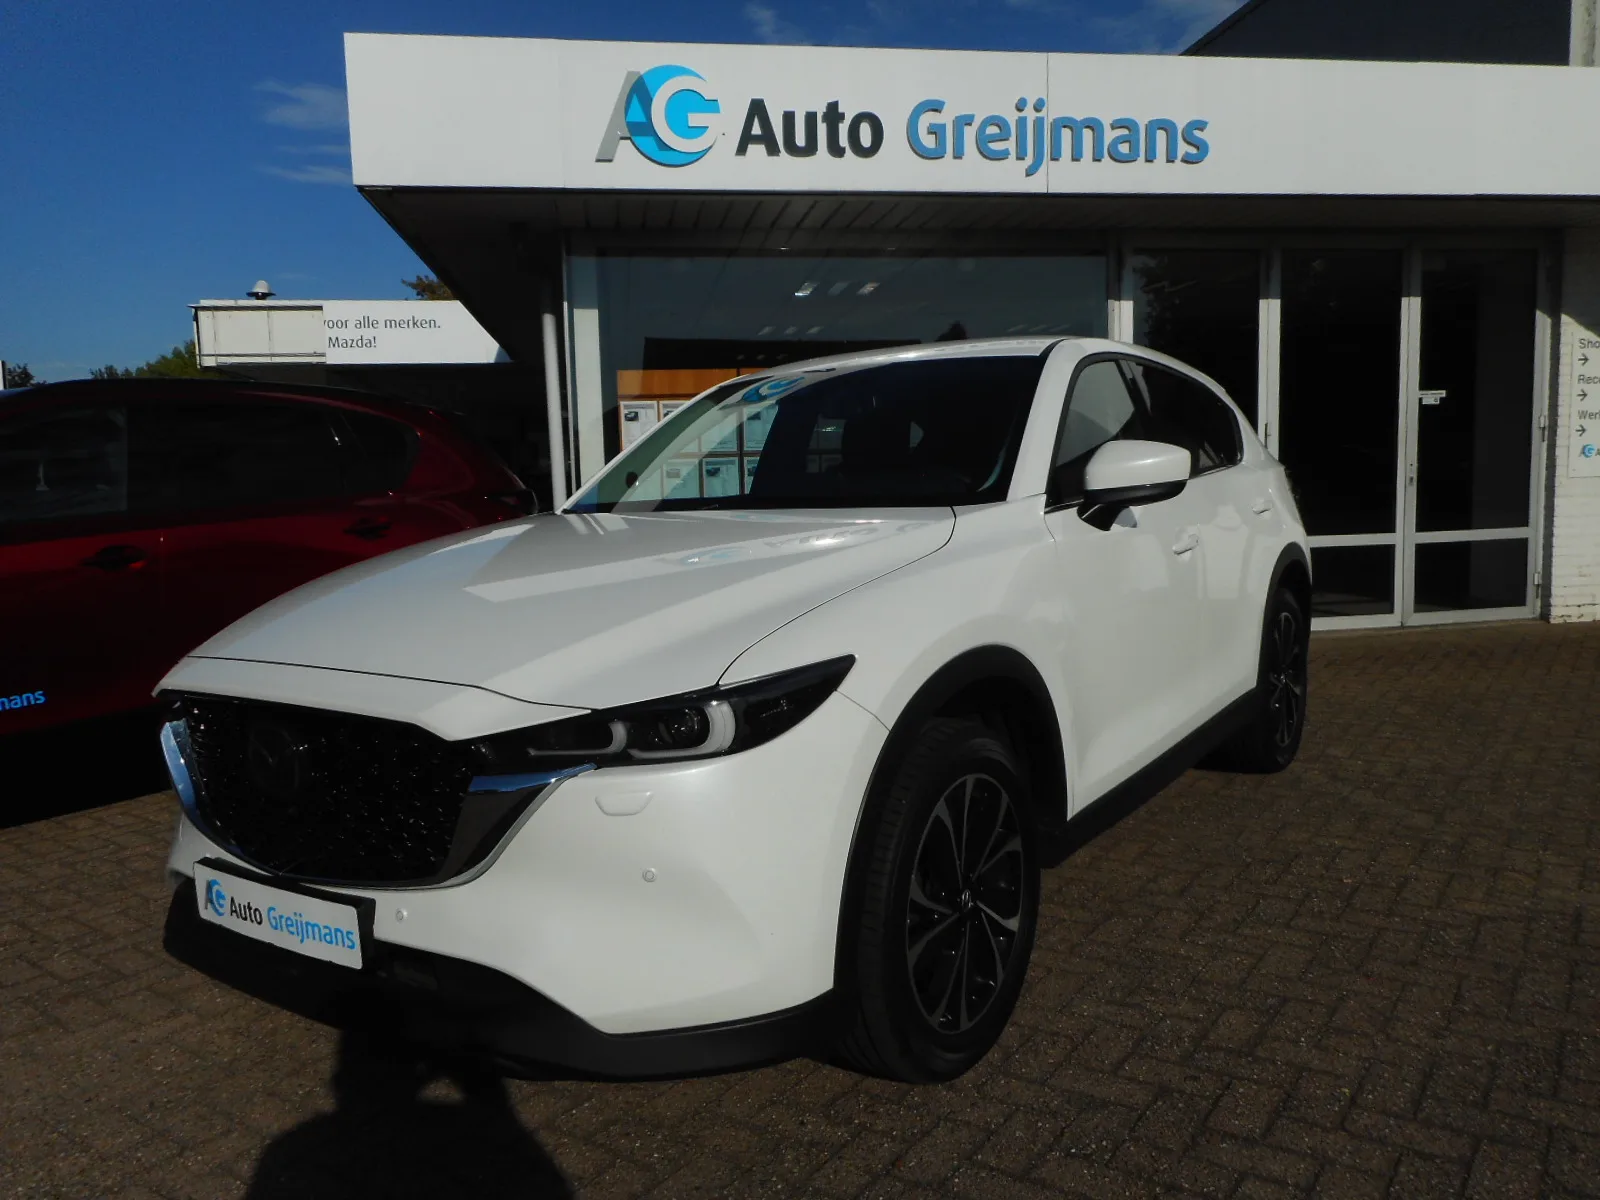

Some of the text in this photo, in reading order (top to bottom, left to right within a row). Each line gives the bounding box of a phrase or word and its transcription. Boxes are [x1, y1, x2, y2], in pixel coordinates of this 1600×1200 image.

[735, 98, 885, 159] Auto
[906, 97, 1210, 178] Greijmans
[354, 316, 379, 330] alle
[384, 316, 441, 330] merken.
[328, 335, 377, 349] Mazda!
[230, 896, 263, 926] Auto
[267, 906, 356, 950] Greijmans
